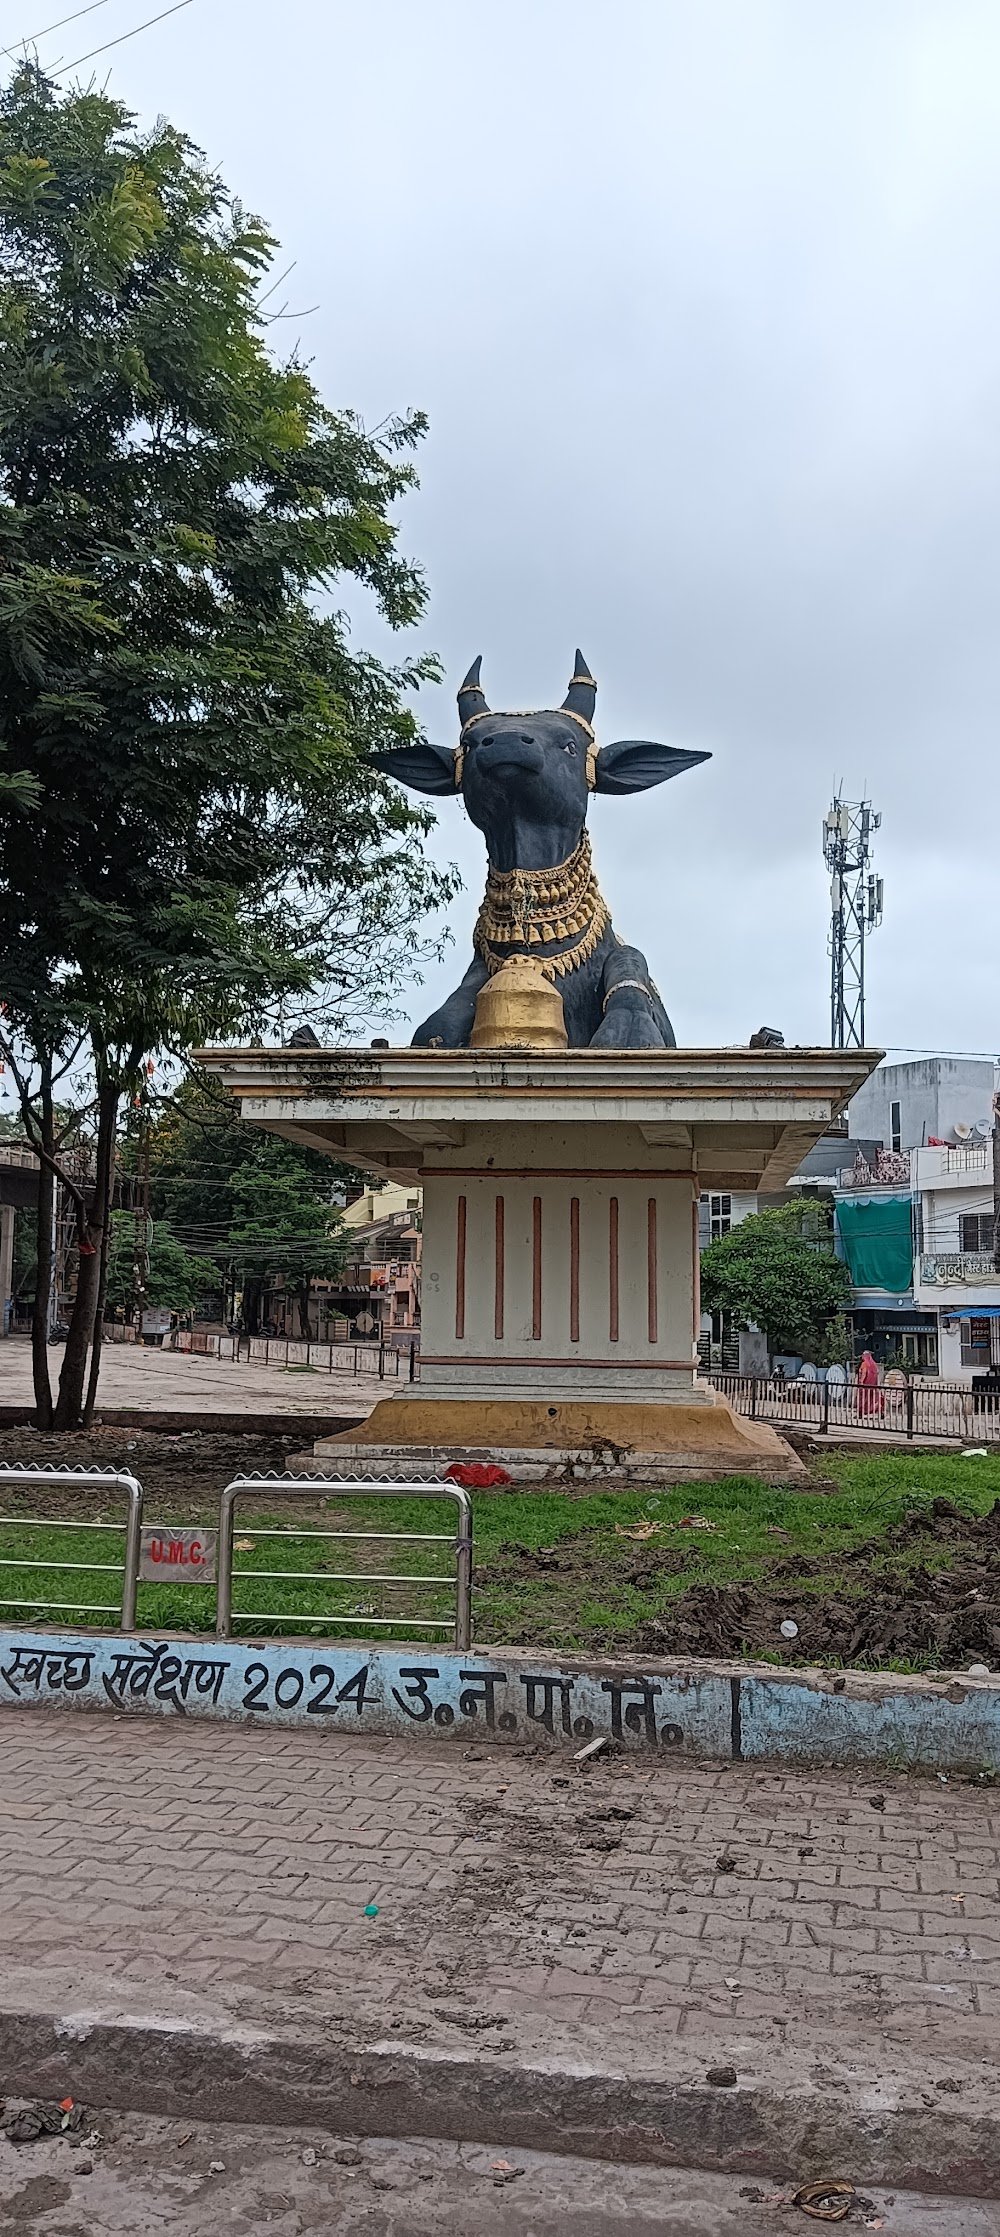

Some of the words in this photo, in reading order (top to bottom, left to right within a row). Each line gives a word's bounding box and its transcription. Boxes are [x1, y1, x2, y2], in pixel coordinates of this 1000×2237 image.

[151, 1540, 206, 1564] U.M.C.
[1, 1647, 96, 1696] स्वच्छ
[103, 1641, 231, 1715] सर्वेक्षण
[242, 1662, 381, 1716] 2024
